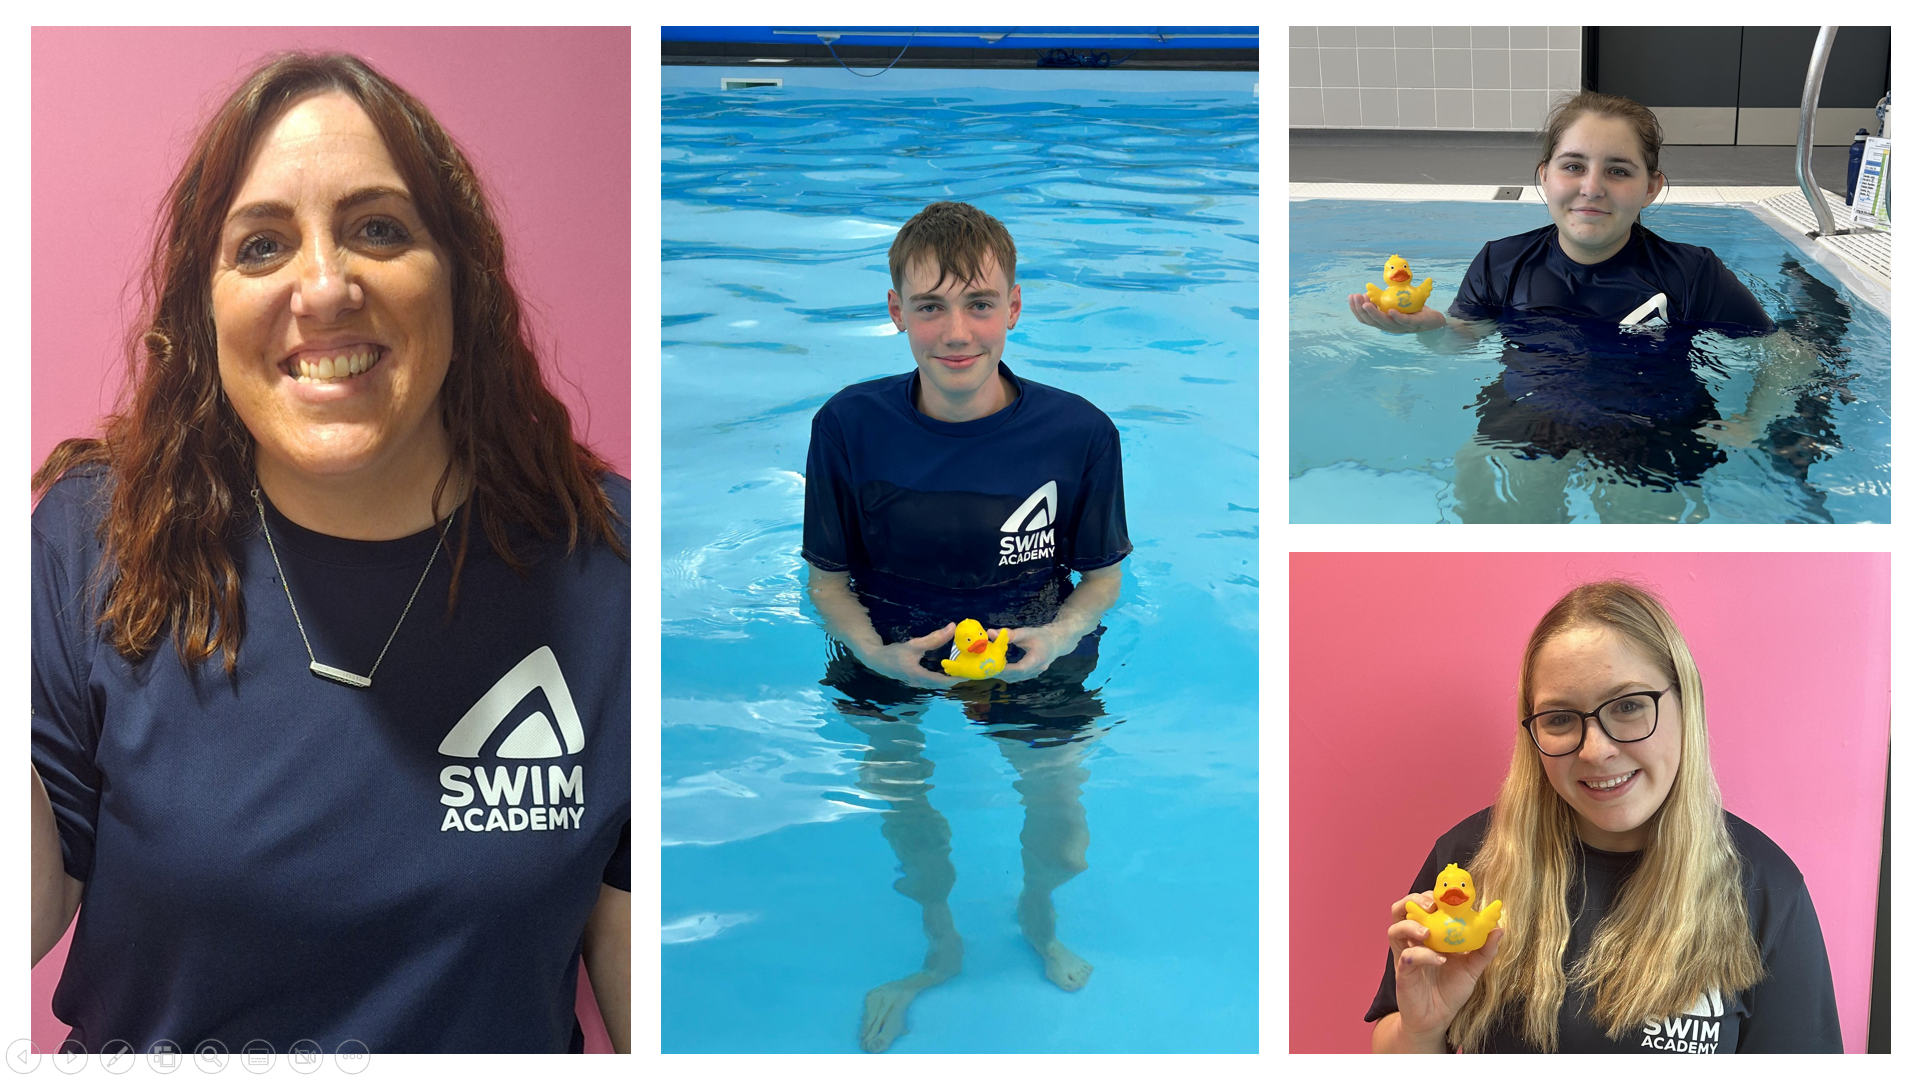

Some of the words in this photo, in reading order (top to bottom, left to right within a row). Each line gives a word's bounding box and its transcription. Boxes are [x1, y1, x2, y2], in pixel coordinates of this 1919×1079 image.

[999, 528, 1055, 555] SWIM
[998, 546, 1055, 566] ACADEMY
[439, 765, 584, 807] SWIM
[440, 807, 585, 832] ACADEMY
[1642, 1014, 1720, 1042] SWIM
[1641, 1035, 1718, 1054] ACADEMY
